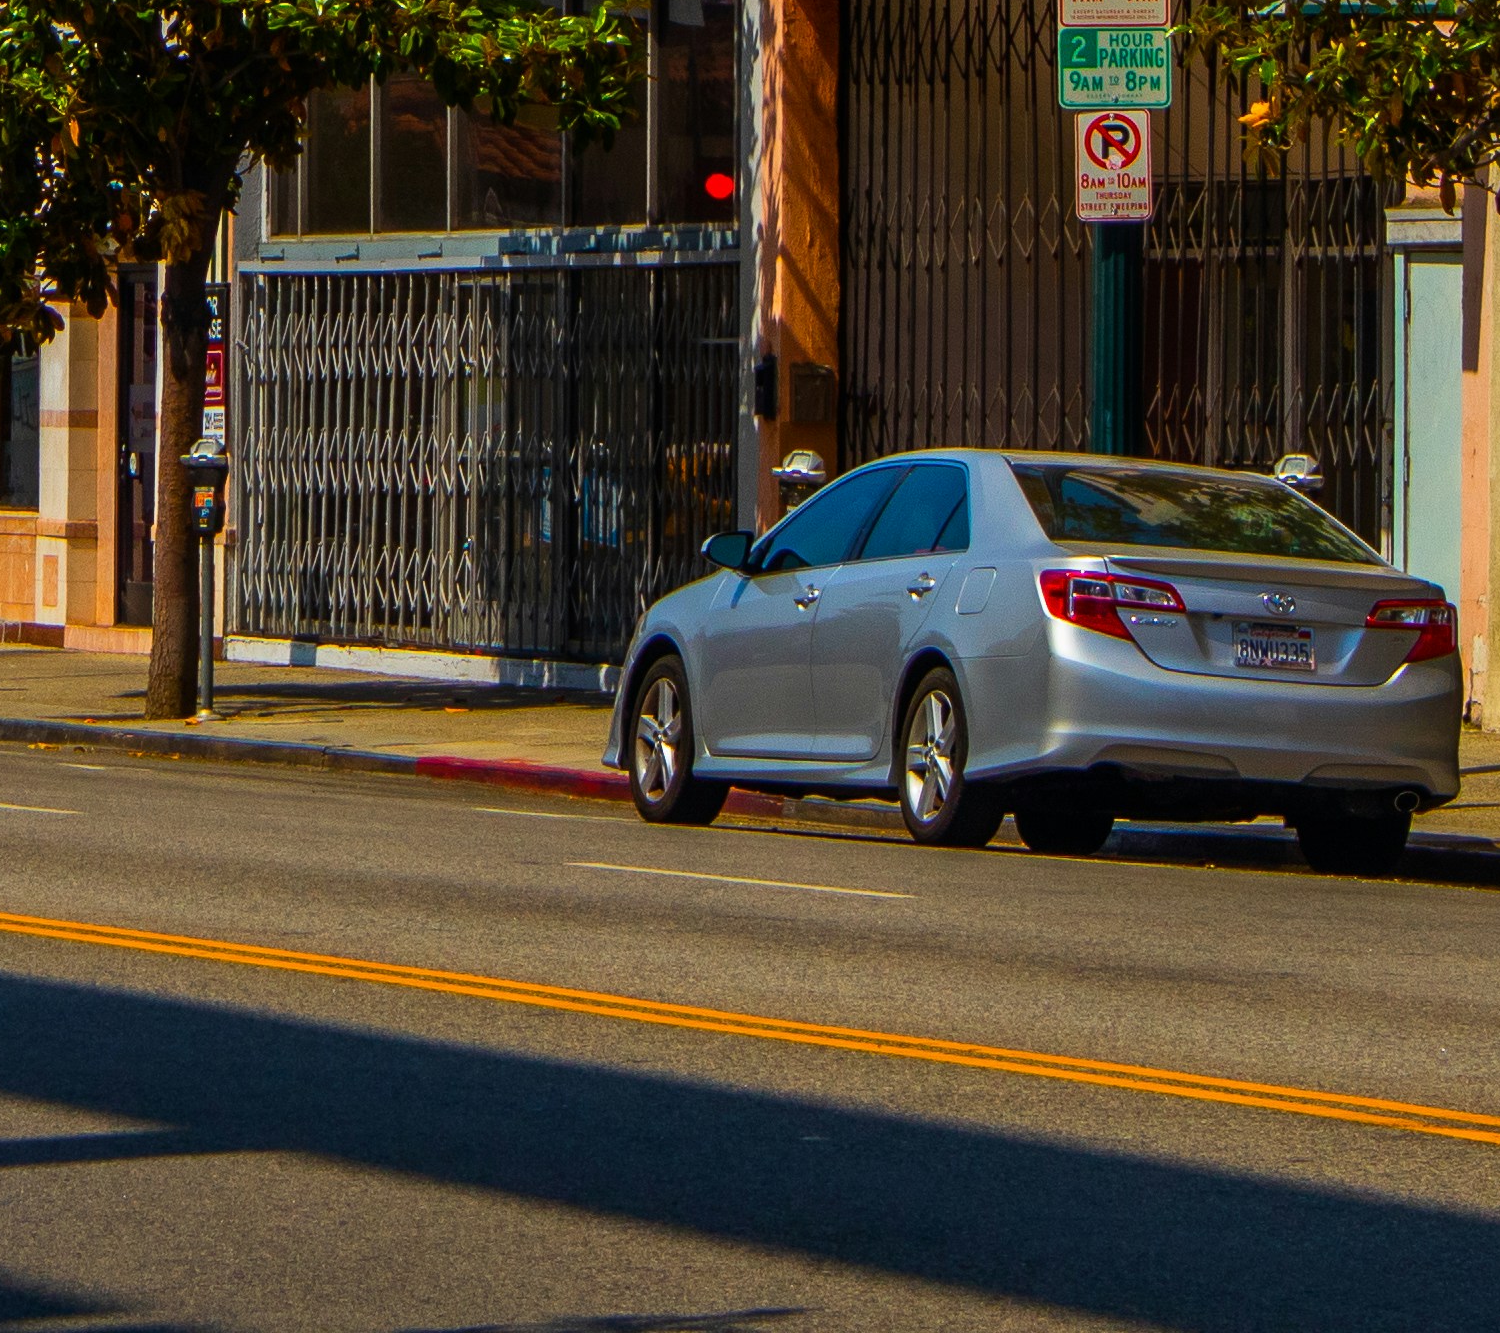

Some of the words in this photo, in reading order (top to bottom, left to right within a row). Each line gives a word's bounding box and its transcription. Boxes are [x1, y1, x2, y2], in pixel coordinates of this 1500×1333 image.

[1071, 35, 1086, 63] 2
[1109, 32, 1154, 48] HOUR
[1098, 47, 1165, 69] PARKING
[1069, 70, 1104, 92] 9AM
[1109, 75, 1120, 86] TO
[1125, 70, 1161, 92] 8PM
[1080, 173, 1105, 189] 8AM
[1116, 173, 1147, 189] 10AM
[1239, 638, 1310, 662] 8NWU335
